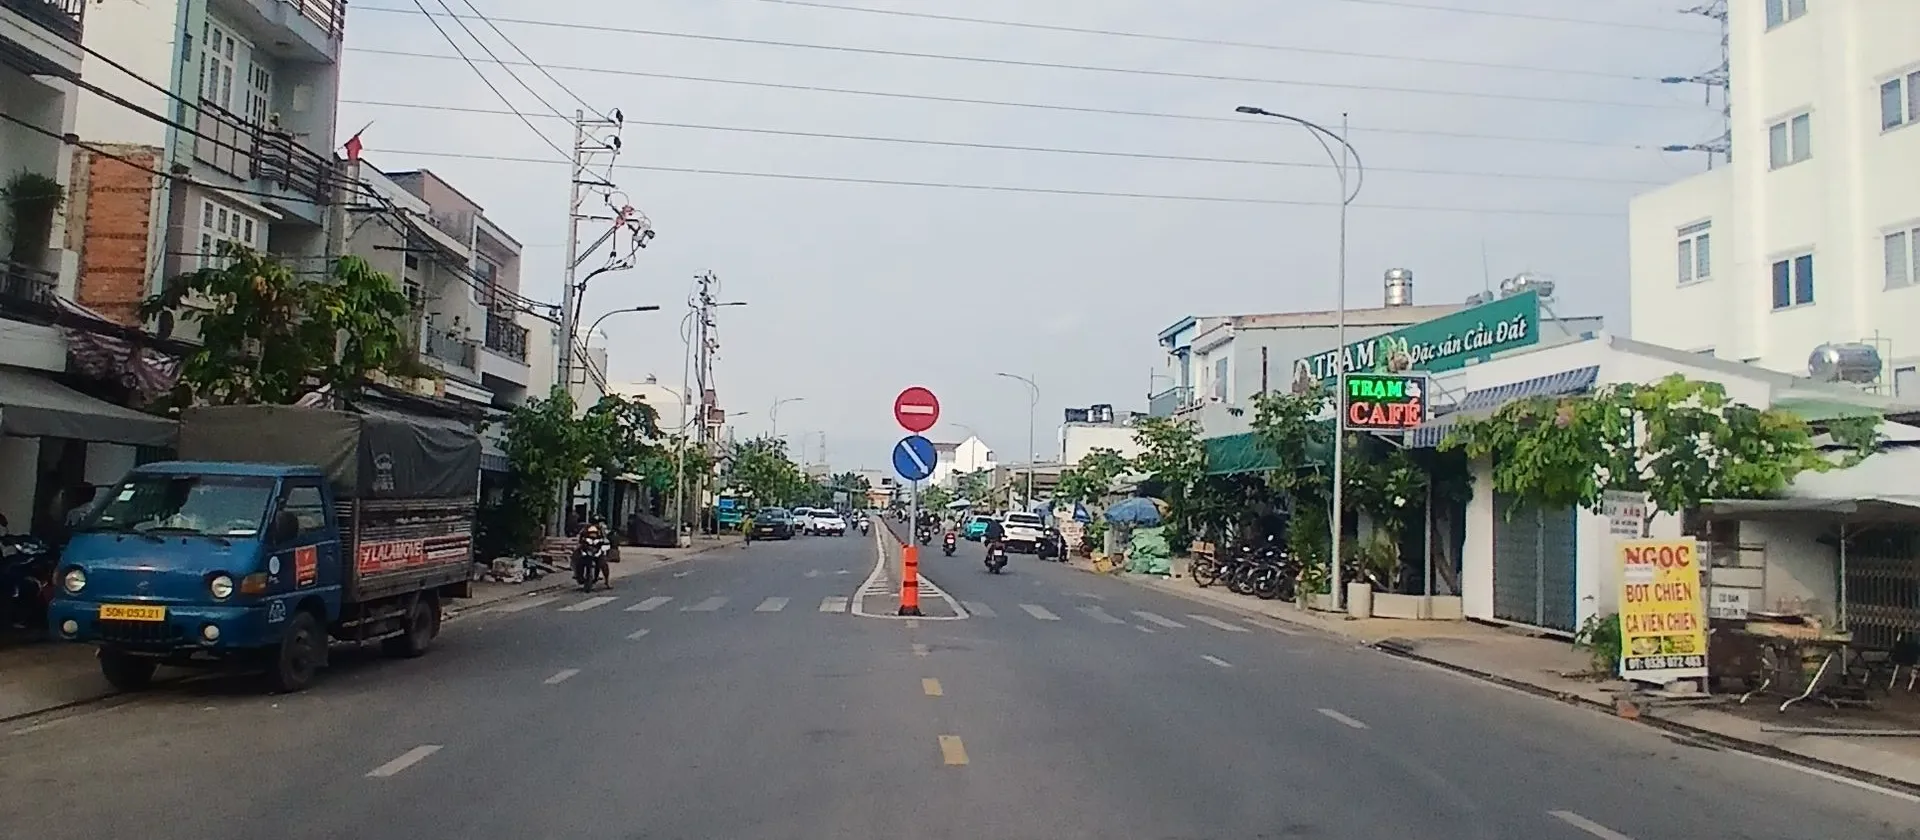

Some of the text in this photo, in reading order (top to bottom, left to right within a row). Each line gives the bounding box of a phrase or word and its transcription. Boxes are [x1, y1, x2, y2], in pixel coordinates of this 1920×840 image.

[1411, 341, 1436, 365] Đặc
[1464, 321, 1493, 351] Cầu
[1496, 313, 1528, 343] Đất
[1348, 379, 1403, 399] TRẠM
[1349, 398, 1422, 426] CAFÉ
[371, 541, 423, 563] LALAMOVE
[1624, 545, 1690, 575] NGỌC
